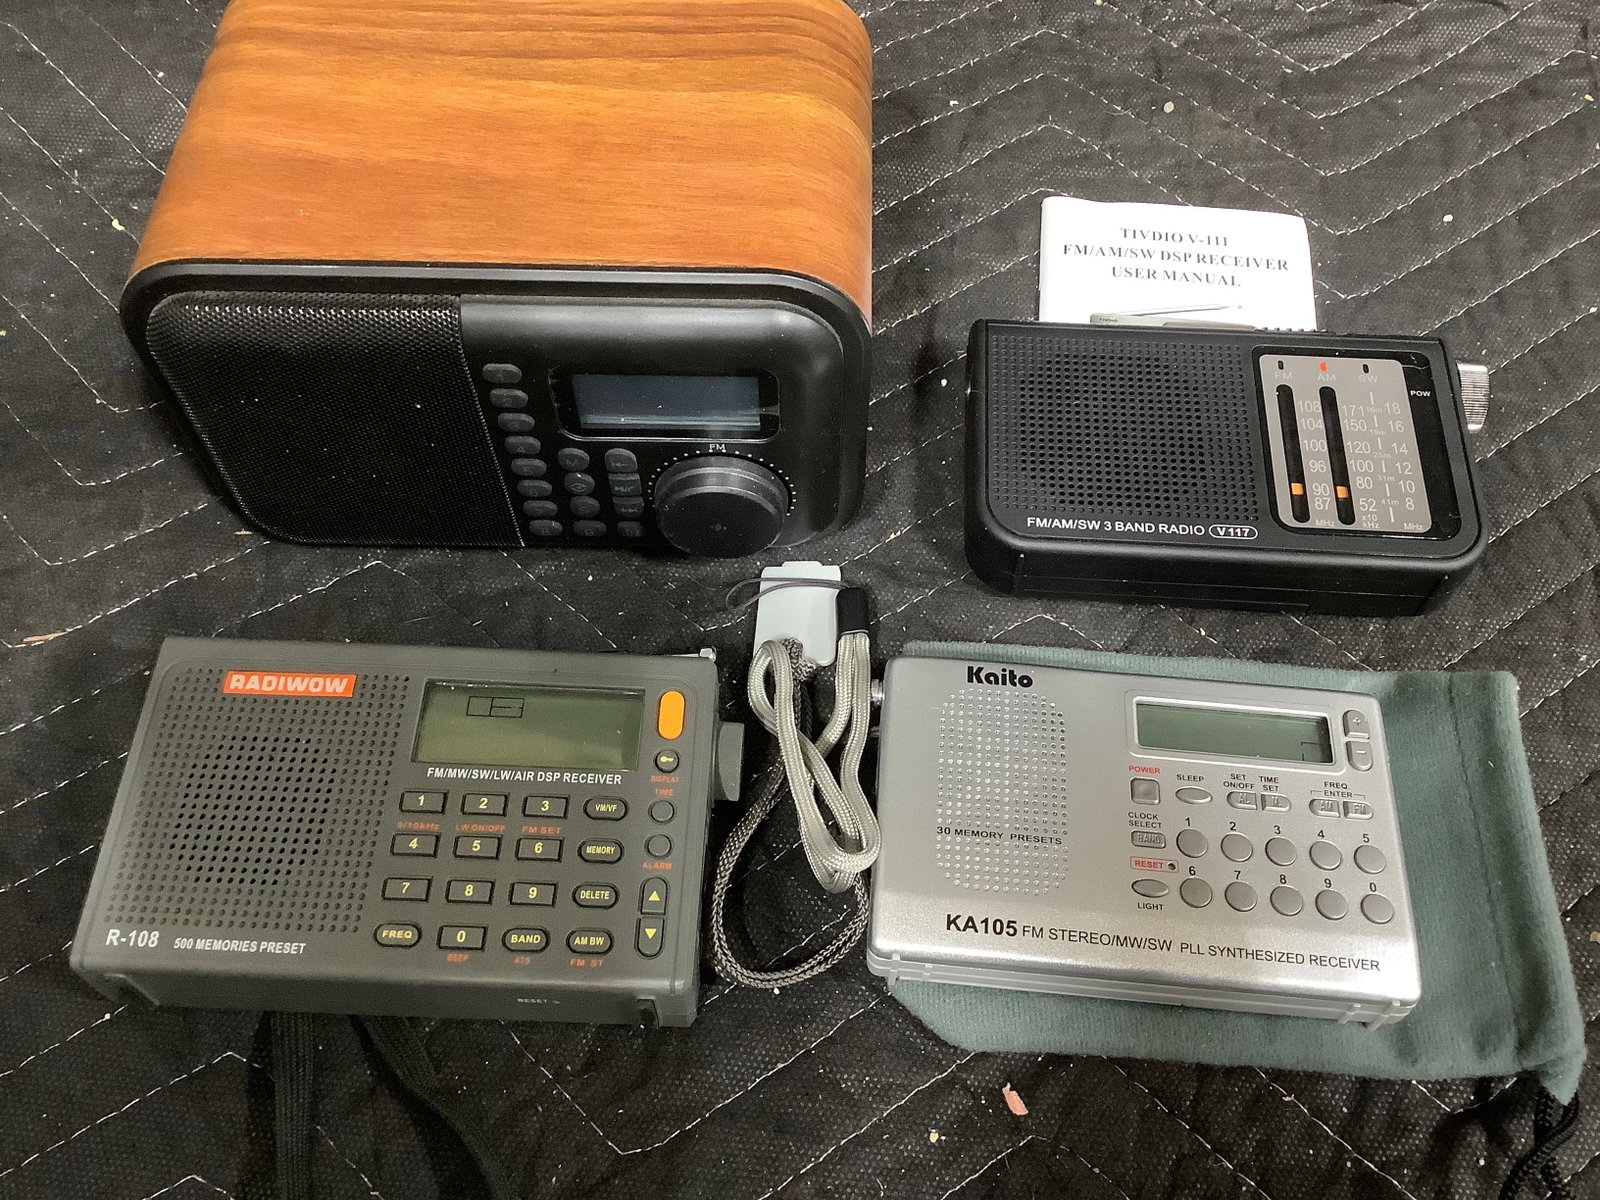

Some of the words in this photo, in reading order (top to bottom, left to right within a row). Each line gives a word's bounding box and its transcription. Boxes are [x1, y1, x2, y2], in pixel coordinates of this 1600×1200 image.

[1120, 227, 1184, 243] TIVDIO
[1188, 234, 1229, 247] V-111
[1063, 244, 1156, 260] FM/AM/SW
[1160, 250, 1192, 263] DSP
[1196, 253, 1289, 271] RECEIVER
[1112, 266, 1158, 280] USER
[1162, 270, 1241, 287] MANUAL
[1275, 371, 1293, 380] FM
[1317, 373, 1336, 382] AM
[1358, 375, 1378, 383] SW
[1297, 401, 1321, 413] 108
[1341, 404, 1365, 417] 171
[1384, 402, 1401, 415] 18
[1300, 418, 1324, 431] 104
[1343, 419, 1367, 432] 150
[1388, 420, 1404, 433] 16
[1303, 440, 1328, 452] 100
[1346, 441, 1371, 454] 120
[1392, 442, 1408, 455] 14
[1309, 460, 1327, 472] 96
[1349, 459, 1374, 473] 100
[1395, 462, 1412, 475] 12
[1356, 476, 1373, 490] 80
[1398, 480, 1415, 493] 10
[1312, 483, 1330, 496] 90
[1314, 497, 1331, 510] 87
[1359, 499, 1377, 511] 52
[1405, 497, 1414, 510] 8
[1026, 517, 1101, 530] FM/AM/SW
[1103, 522, 1112, 531] 3
[1115, 522, 1155, 533] BAND
[1158, 523, 1205, 535] RADIO
[1315, 519, 1336, 527] MHz
[1362, 521, 1380, 529] kHz
[1216, 527, 1251, 537] V117
[967, 665, 1034, 688] Kaito
[229, 674, 348, 693] RADIWOW
[1128, 765, 1160, 774] POWER
[427, 767, 534, 782] FM/MW/SW/LW/AIR
[537, 771, 561, 782] DSP
[563, 773, 622, 785] RECEIVER
[1176, 774, 1204, 782] SLEEP
[1230, 773, 1246, 781] SET
[1223, 780, 1255, 790] ON/OFF
[1324, 781, 1348, 790] FREQ
[1324, 790, 1353, 798] ENTER
[418, 795, 425, 806] 1
[479, 797, 488, 809] 2
[541, 800, 549, 812] 3
[595, 804, 617, 813] VM/VF
[1128, 812, 1158, 820] CLOCK
[1128, 820, 1162, 829] SELECT
[1185, 818, 1191, 826] 1
[1229, 822, 1236, 831] 2
[521, 826, 539, 834] FM
[541, 826, 562, 835] SET
[936, 826, 951, 835] 30
[954, 829, 1004, 839] MEMORY
[1010, 833, 1062, 845] PRESETS
[1274, 825, 1281, 835] 3
[1317, 829, 1325, 839] 4
[409, 838, 418, 849] 4
[1362, 834, 1370, 843] 5
[472, 840, 481, 851] 5
[534, 842, 543, 853] 6
[586, 846, 615, 855] MEMORY
[642, 861, 673, 871] ALARM
[1135, 860, 1164, 869] RESET
[1188, 866, 1196, 876] 6
[1234, 870, 1241, 880] 7
[1279, 874, 1286, 884] 8
[1324, 878, 1332, 888] 9
[401, 882, 411, 894] 7
[464, 884, 474, 896] 8
[1369, 882, 1377, 892] 0
[528, 887, 537, 899] 9
[580, 890, 610, 900] DELETE
[1137, 902, 1164, 911] LIGHT
[105, 928, 160, 947] R-108
[382, 930, 412, 939] FREQ
[456, 931, 466, 942] 0
[511, 934, 541, 944] BAND
[173, 937, 194, 950] 500
[195, 938, 258, 952] MEMORIES
[259, 941, 306, 954] PRESET
[574, 937, 587, 946] AM
[588, 937, 604, 946] BW
[946, 914, 1018, 937] KA105
[1022, 926, 1044, 939] FM
[1048, 927, 1173, 952] STEREO/MW/SW
[1180, 944, 1204, 955] PLL
[1207, 944, 1305, 965] SYNTHESIZED
[1309, 955, 1380, 972] RECEIVER
[570, 958, 585, 966] FM
